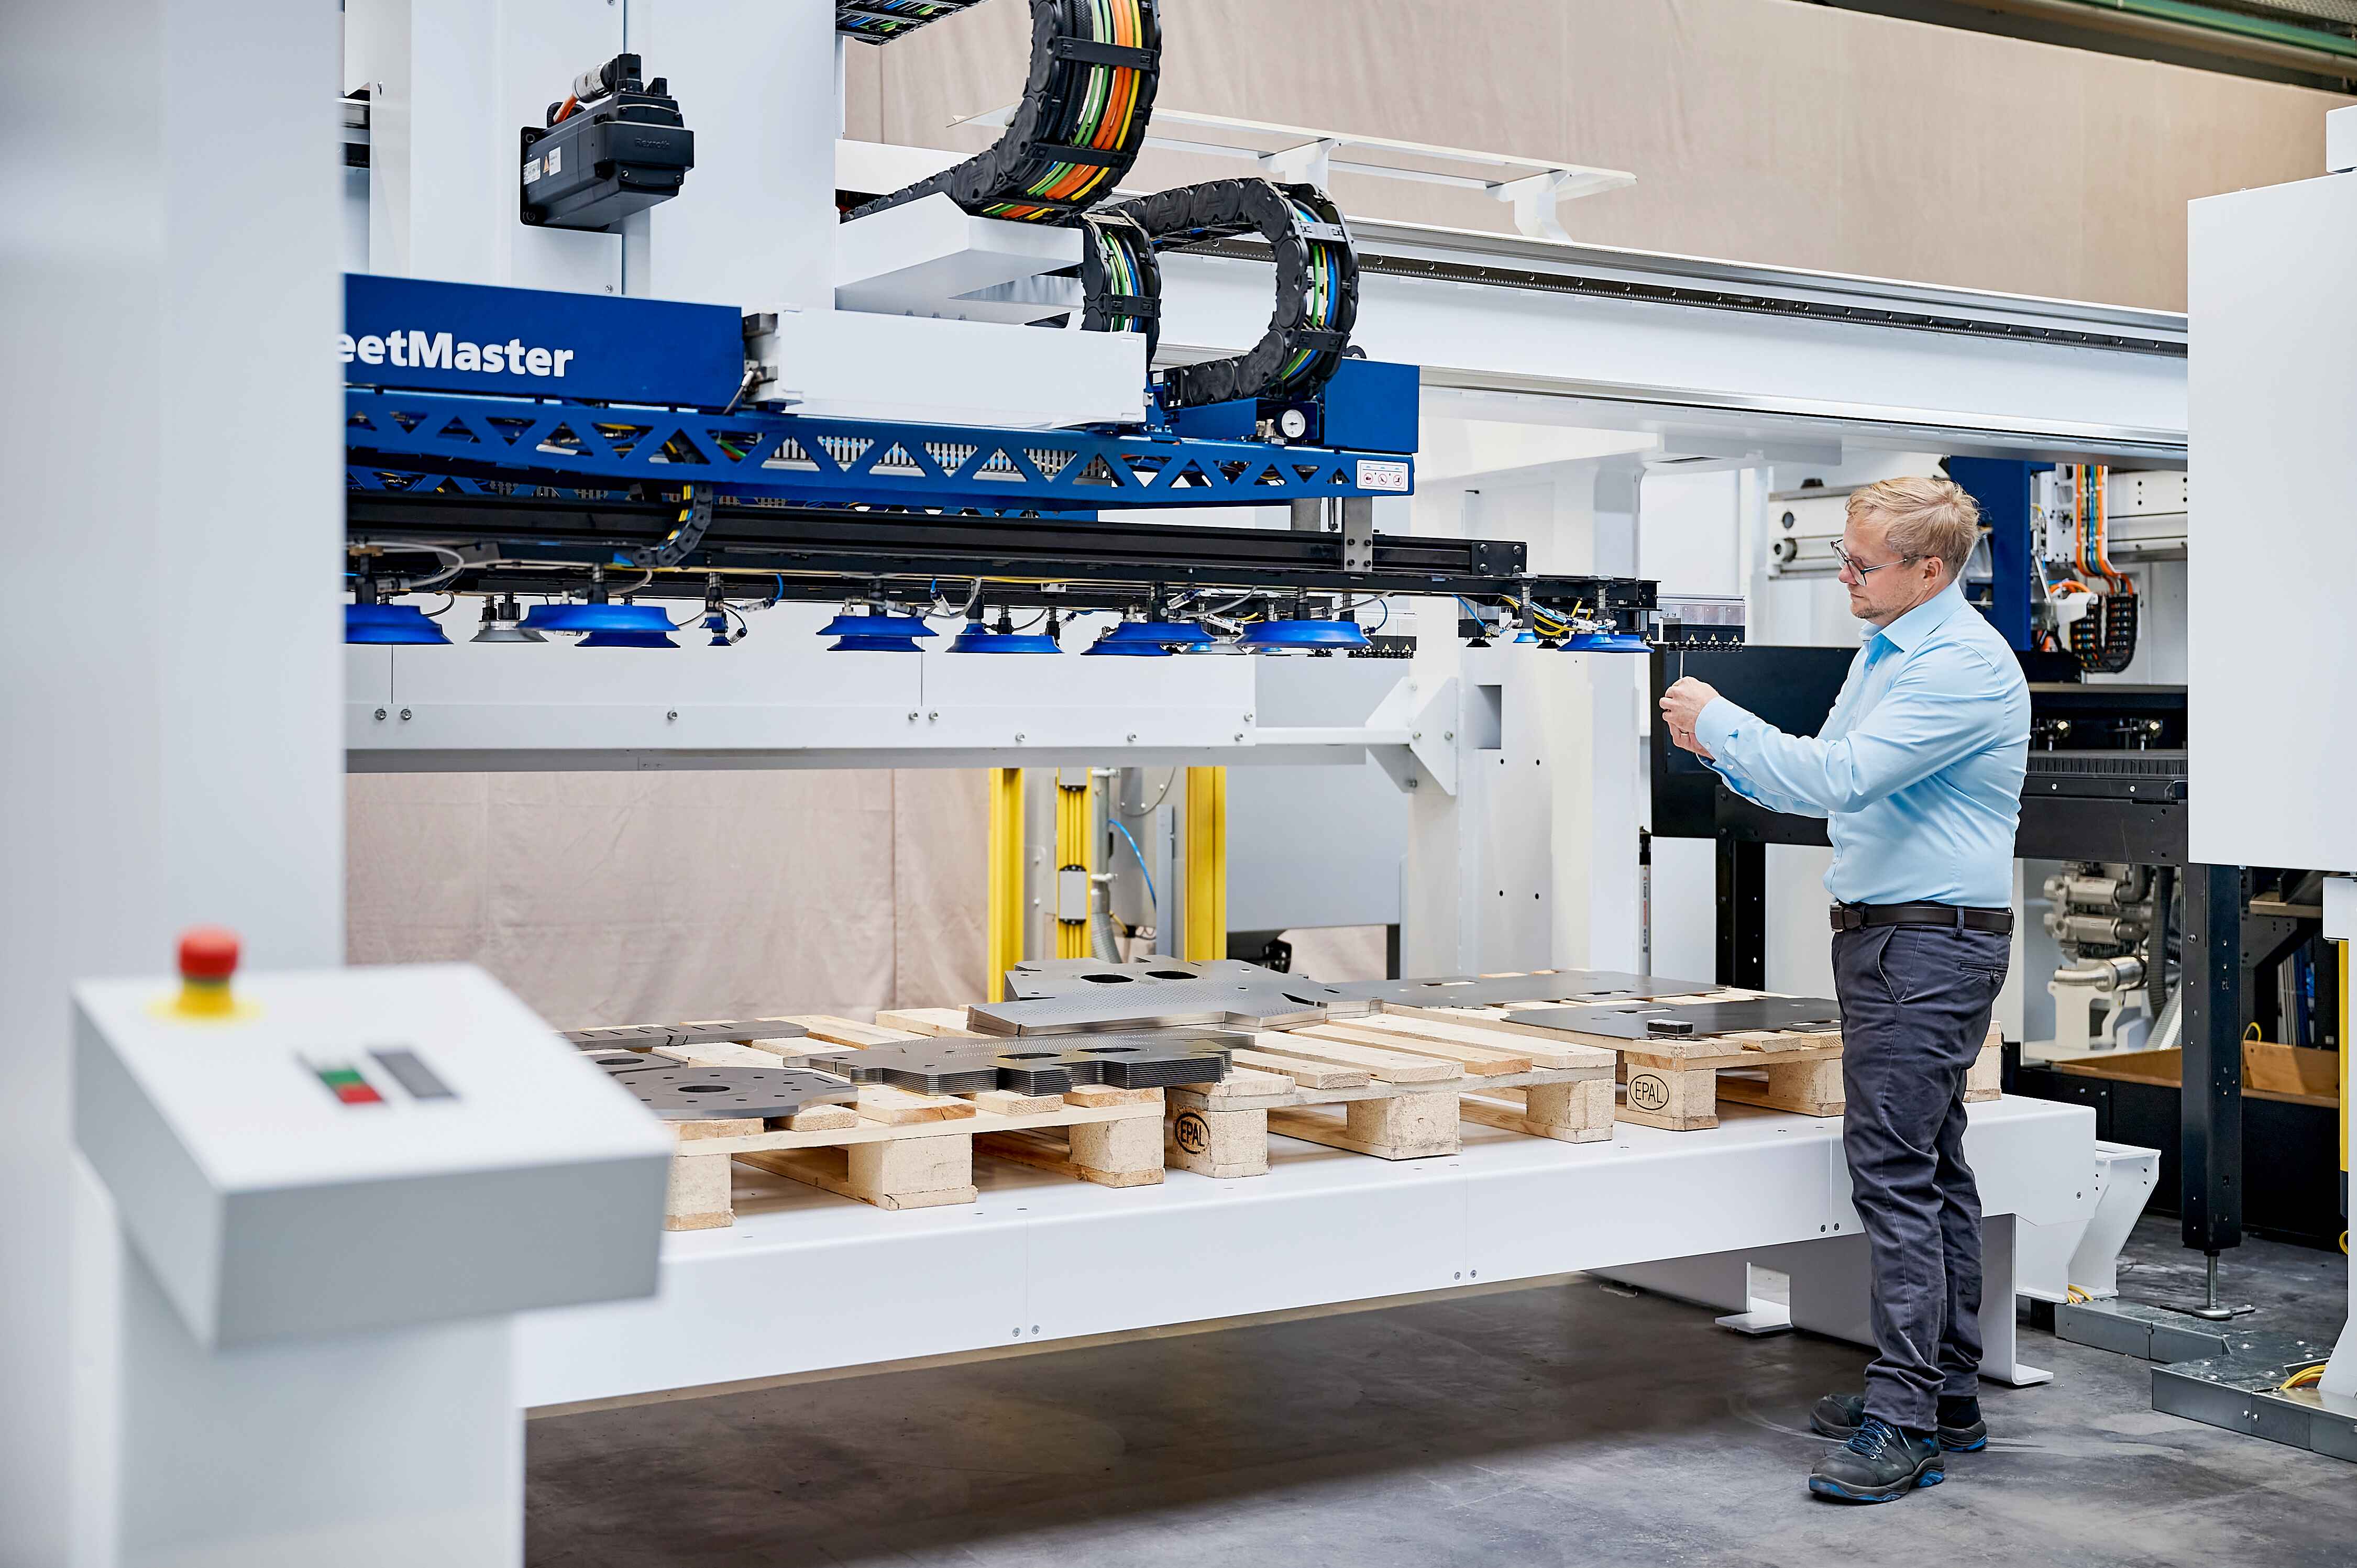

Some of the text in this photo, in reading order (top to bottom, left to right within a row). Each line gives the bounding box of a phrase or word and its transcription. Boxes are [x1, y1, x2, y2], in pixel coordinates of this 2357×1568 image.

[634, 138, 671, 149] Rexroth
[336, 329, 574, 377] eetMaster
[1635, 1081, 1663, 1103] EPAL
[1180, 1120, 1205, 1147] EPAL
